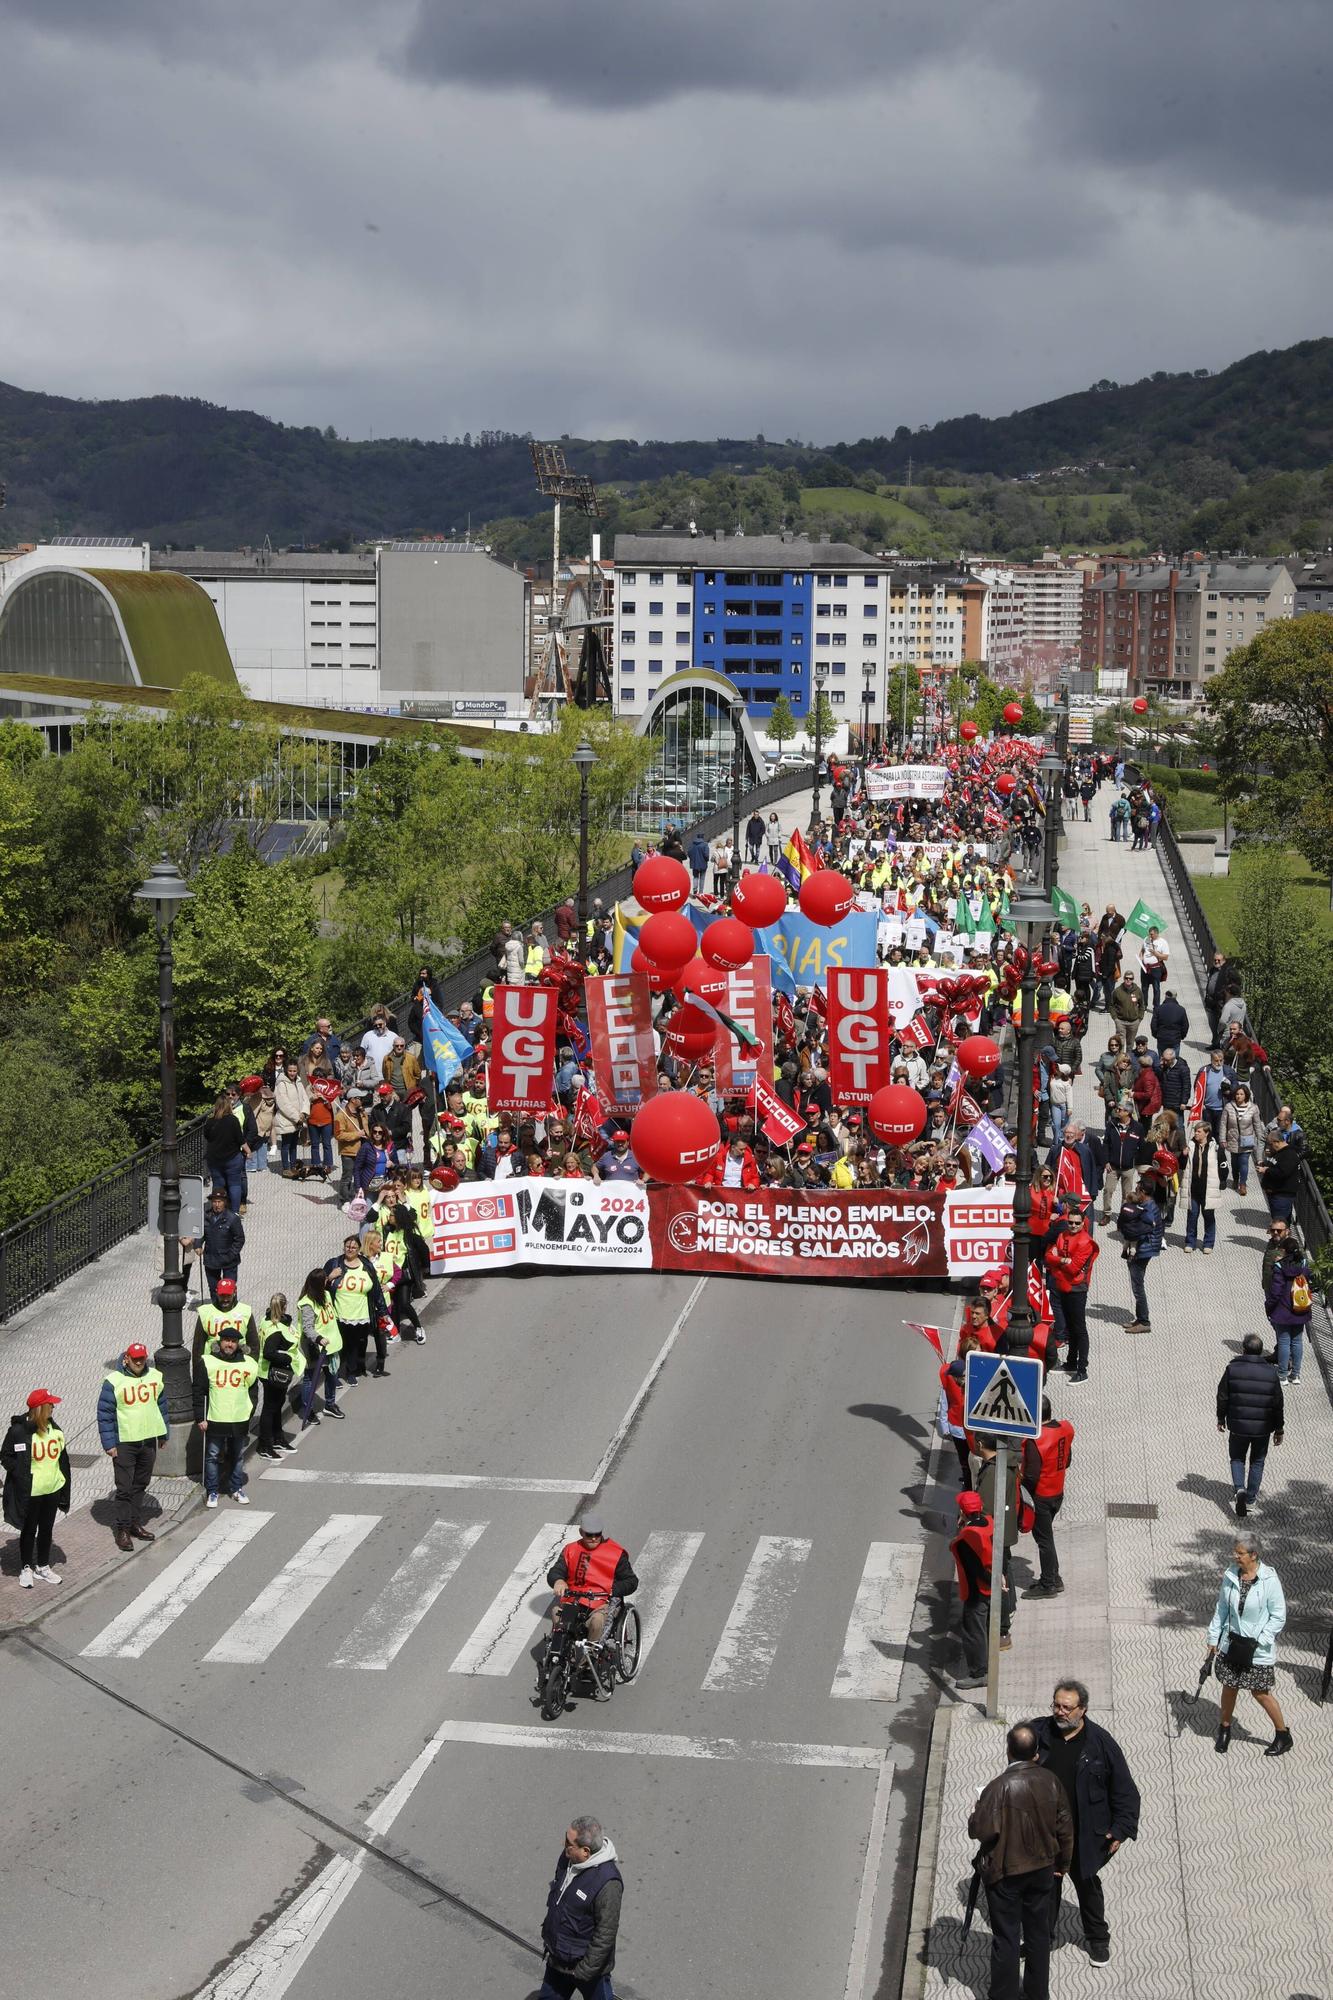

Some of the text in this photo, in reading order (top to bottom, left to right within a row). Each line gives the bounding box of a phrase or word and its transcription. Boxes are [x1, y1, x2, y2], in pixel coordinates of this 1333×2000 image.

[837, 973, 879, 1090] UGT
[910, 1018, 928, 1044] CCOO
[501, 991, 548, 1098] UGT
[496, 1099, 546, 1109] ASTURIAS
[838, 1091, 872, 1102] ASTURI
[874, 1120, 914, 1133] CCOO
[433, 1202, 473, 1226] UGT
[600, 1197, 645, 1214] 2024
[697, 1199, 935, 1223] POR EL PLENO EMPLEO:
[953, 1208, 1014, 1224] CCOO
[697, 1218, 882, 1241] MENOS JORNADA,
[386, 1240, 401, 1256] GT
[434, 1235, 489, 1257] CCOO
[525, 1241, 582, 1252] #PLENOEMPLEO
[591, 1245, 643, 1254] #1MAYO2024
[697, 1236, 901, 1258] MEJORES SALARIOS
[956, 1241, 1002, 1260] UGT
[216, 1368, 251, 1388] UGT
[123, 1382, 158, 1406] UGT
[32, 1439, 61, 1461] UG
